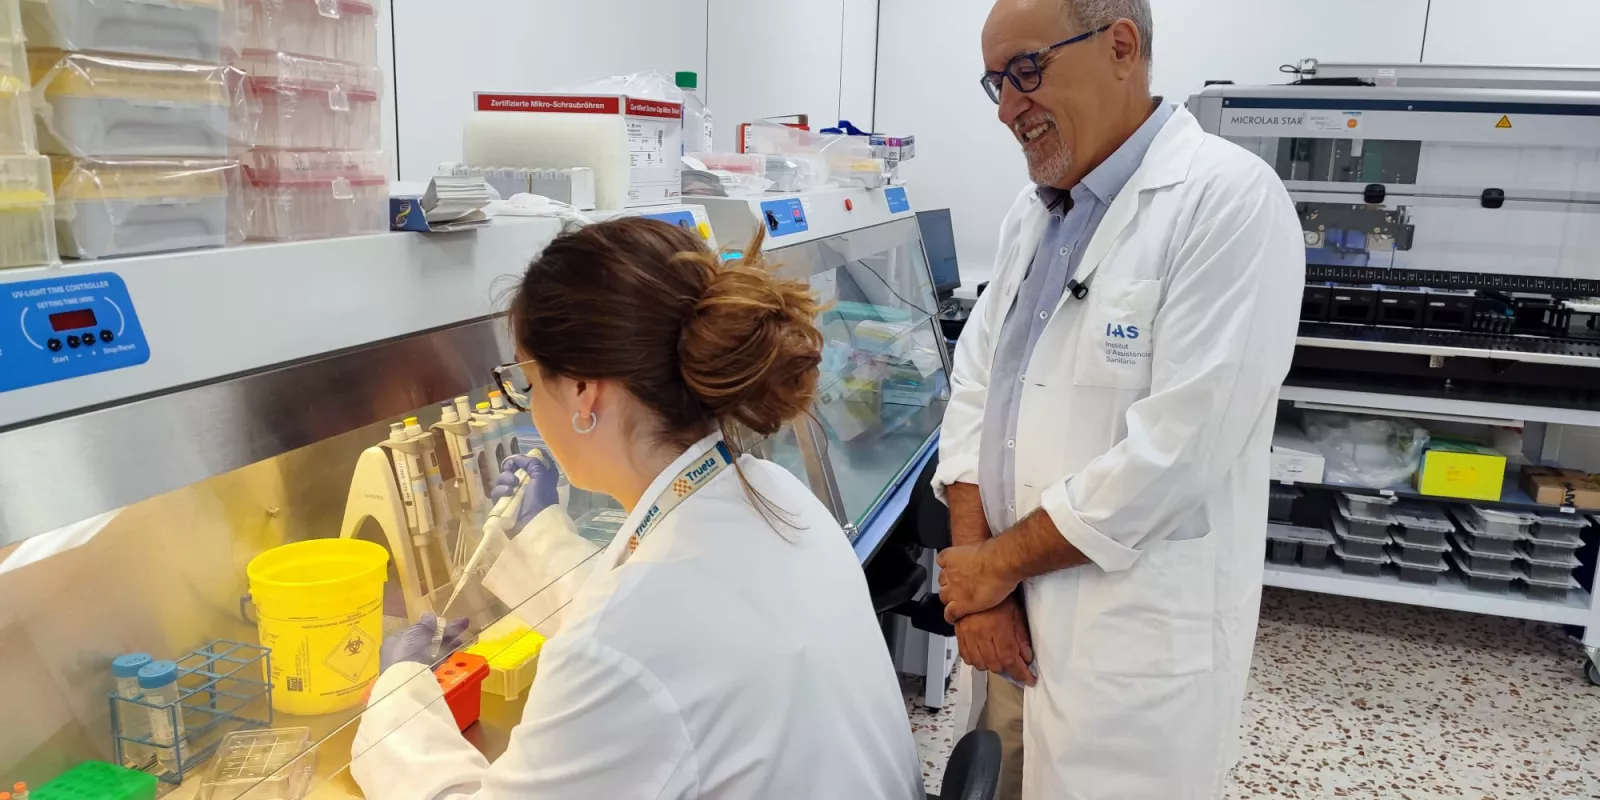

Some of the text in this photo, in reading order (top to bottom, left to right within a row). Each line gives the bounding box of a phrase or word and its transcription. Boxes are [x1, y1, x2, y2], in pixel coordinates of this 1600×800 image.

[490, 99, 605, 110] Zertifizierte Mikro-Schraubröhren
[1230, 116, 1279, 125] MICROLAB
[1281, 116, 1303, 125] STAR
[12, 281, 109, 299] UV-LIGHT TIME CONTROLLER
[1106, 323, 1139, 339] IAS
[1105, 341, 1128, 349] Institut
[52, 355, 69, 363] Start
[685, 457, 716, 481] Trueta
[635, 505, 659, 536] Trueta
